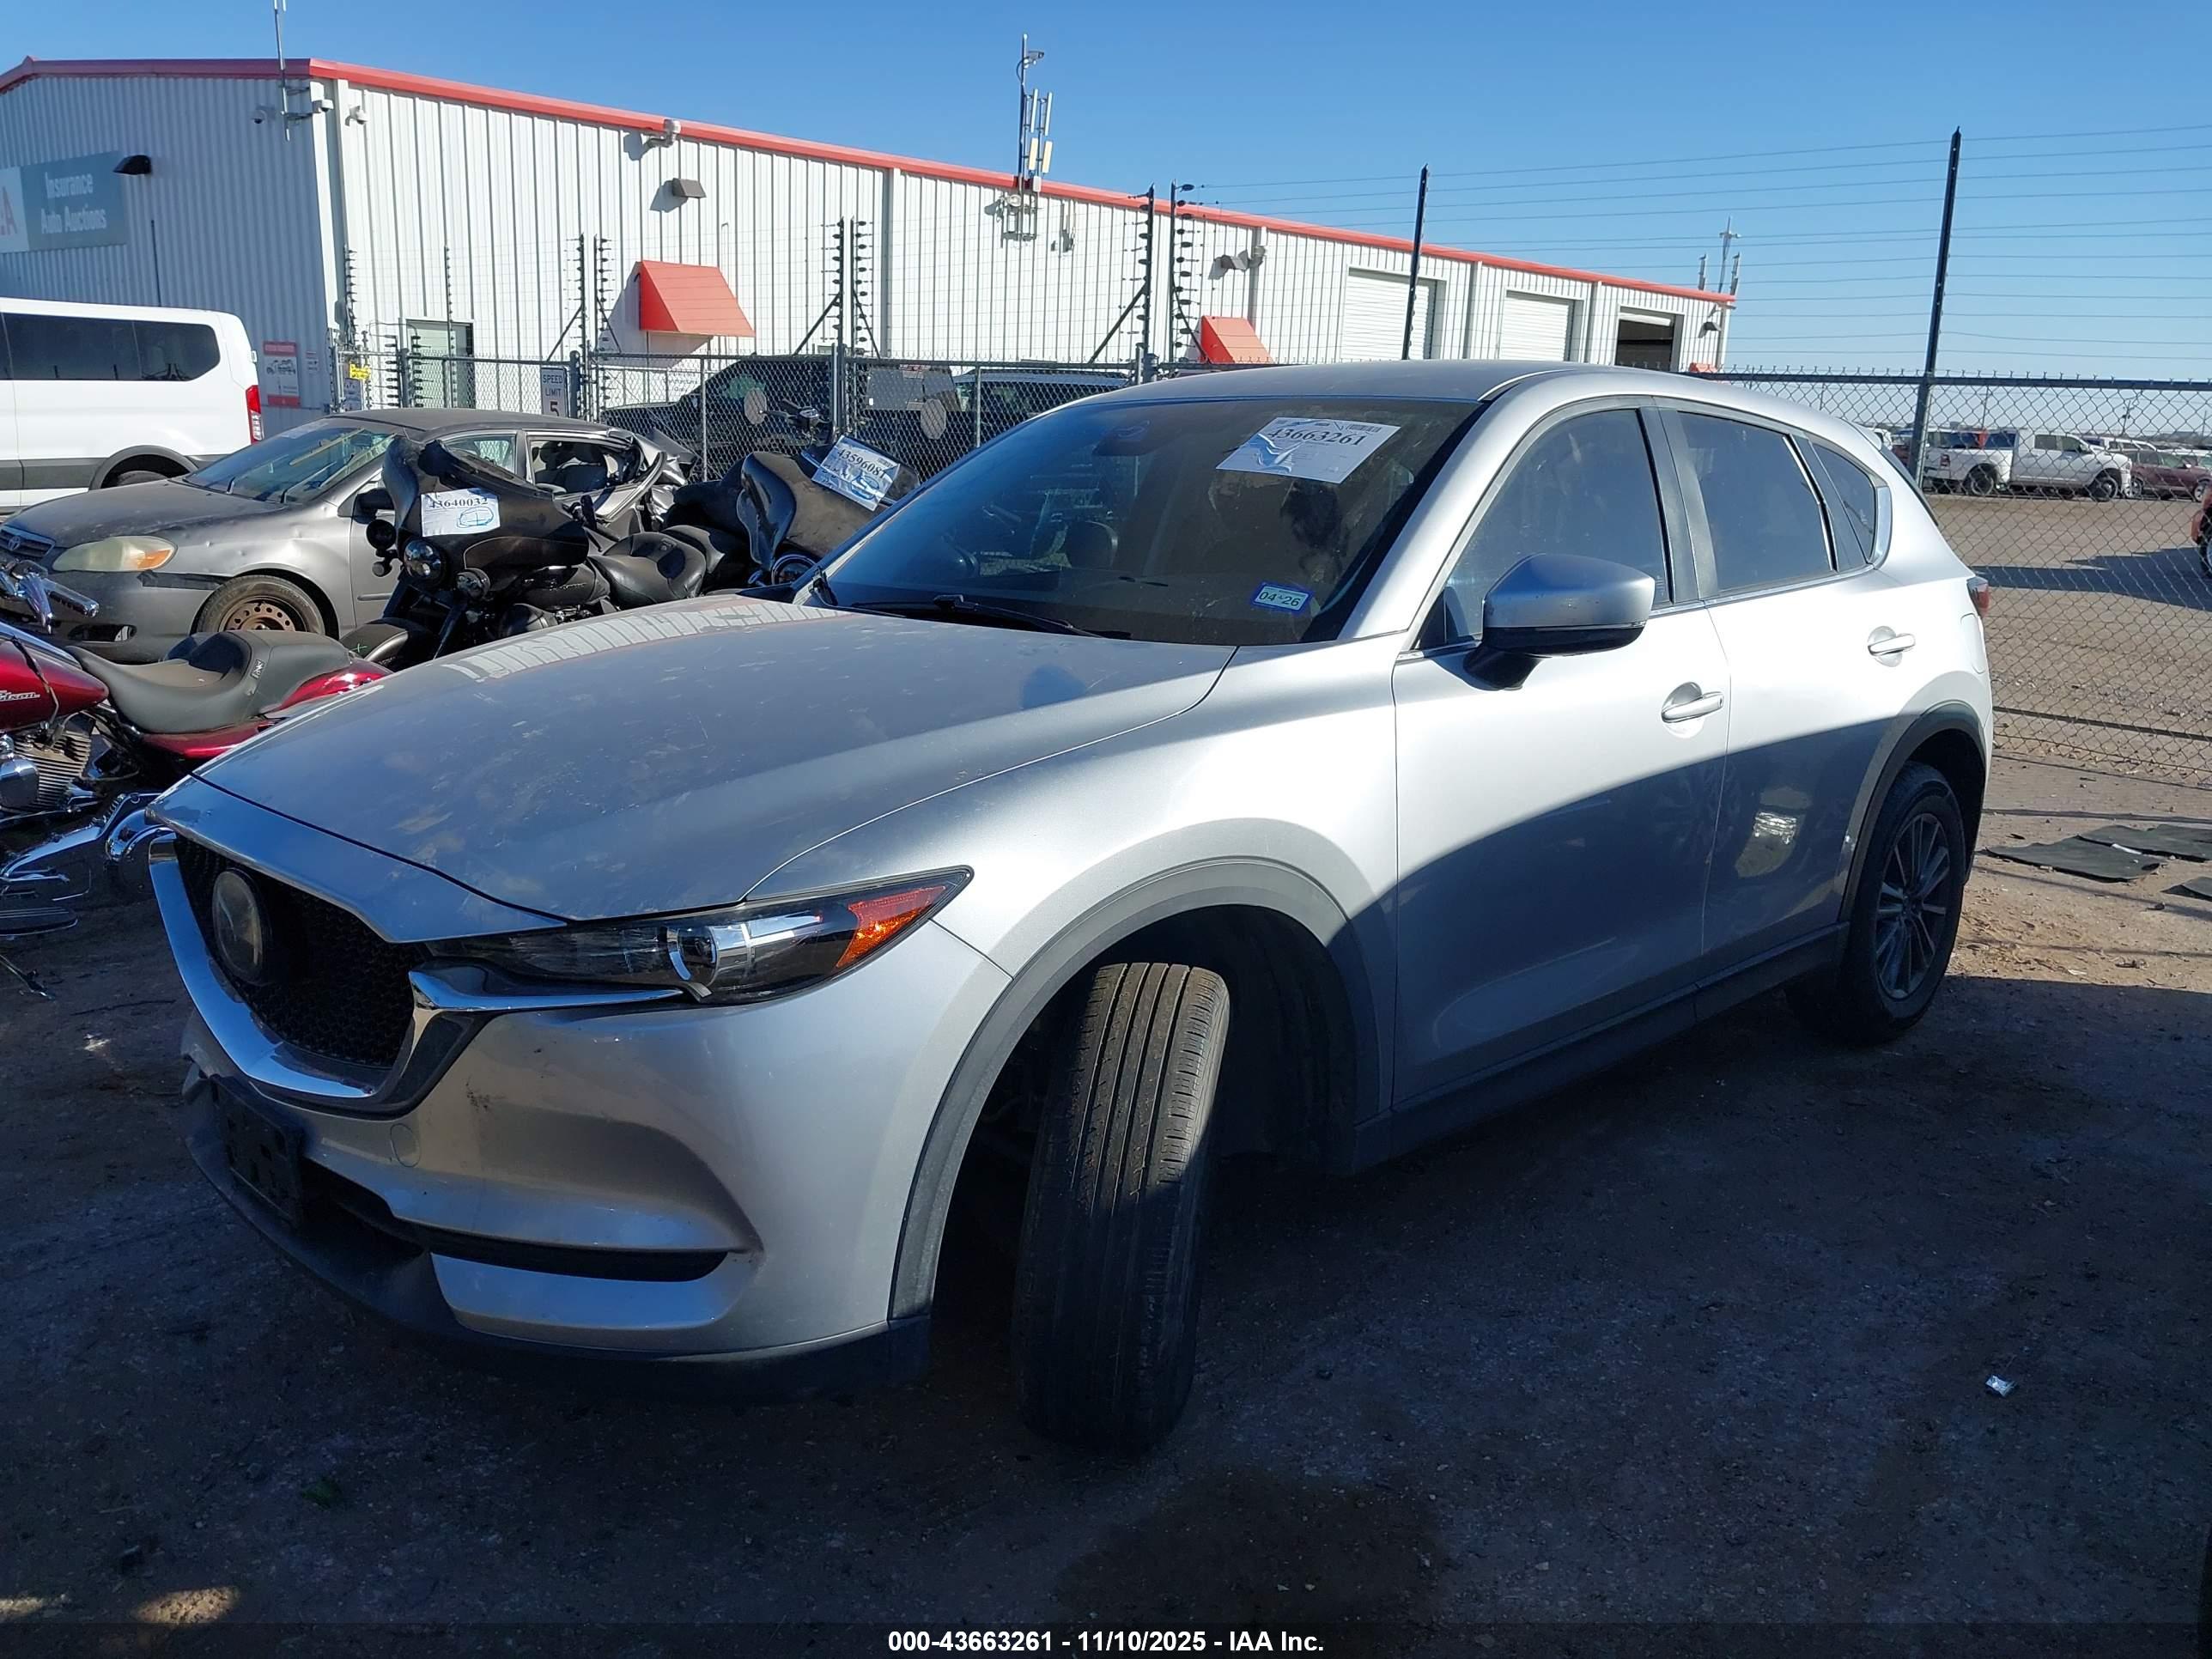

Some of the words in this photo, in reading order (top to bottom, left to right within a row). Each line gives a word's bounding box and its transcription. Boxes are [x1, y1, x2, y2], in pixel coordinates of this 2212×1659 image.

[45, 171, 93, 199] Insurance
[40, 208, 63, 234] Auto
[64, 203, 107, 233] Auctions
[542, 374, 563, 384] SPEED
[545, 387, 561, 398] LIMIT
[550, 401, 560, 417] 5
[1267, 428, 1367, 447] 43663261
